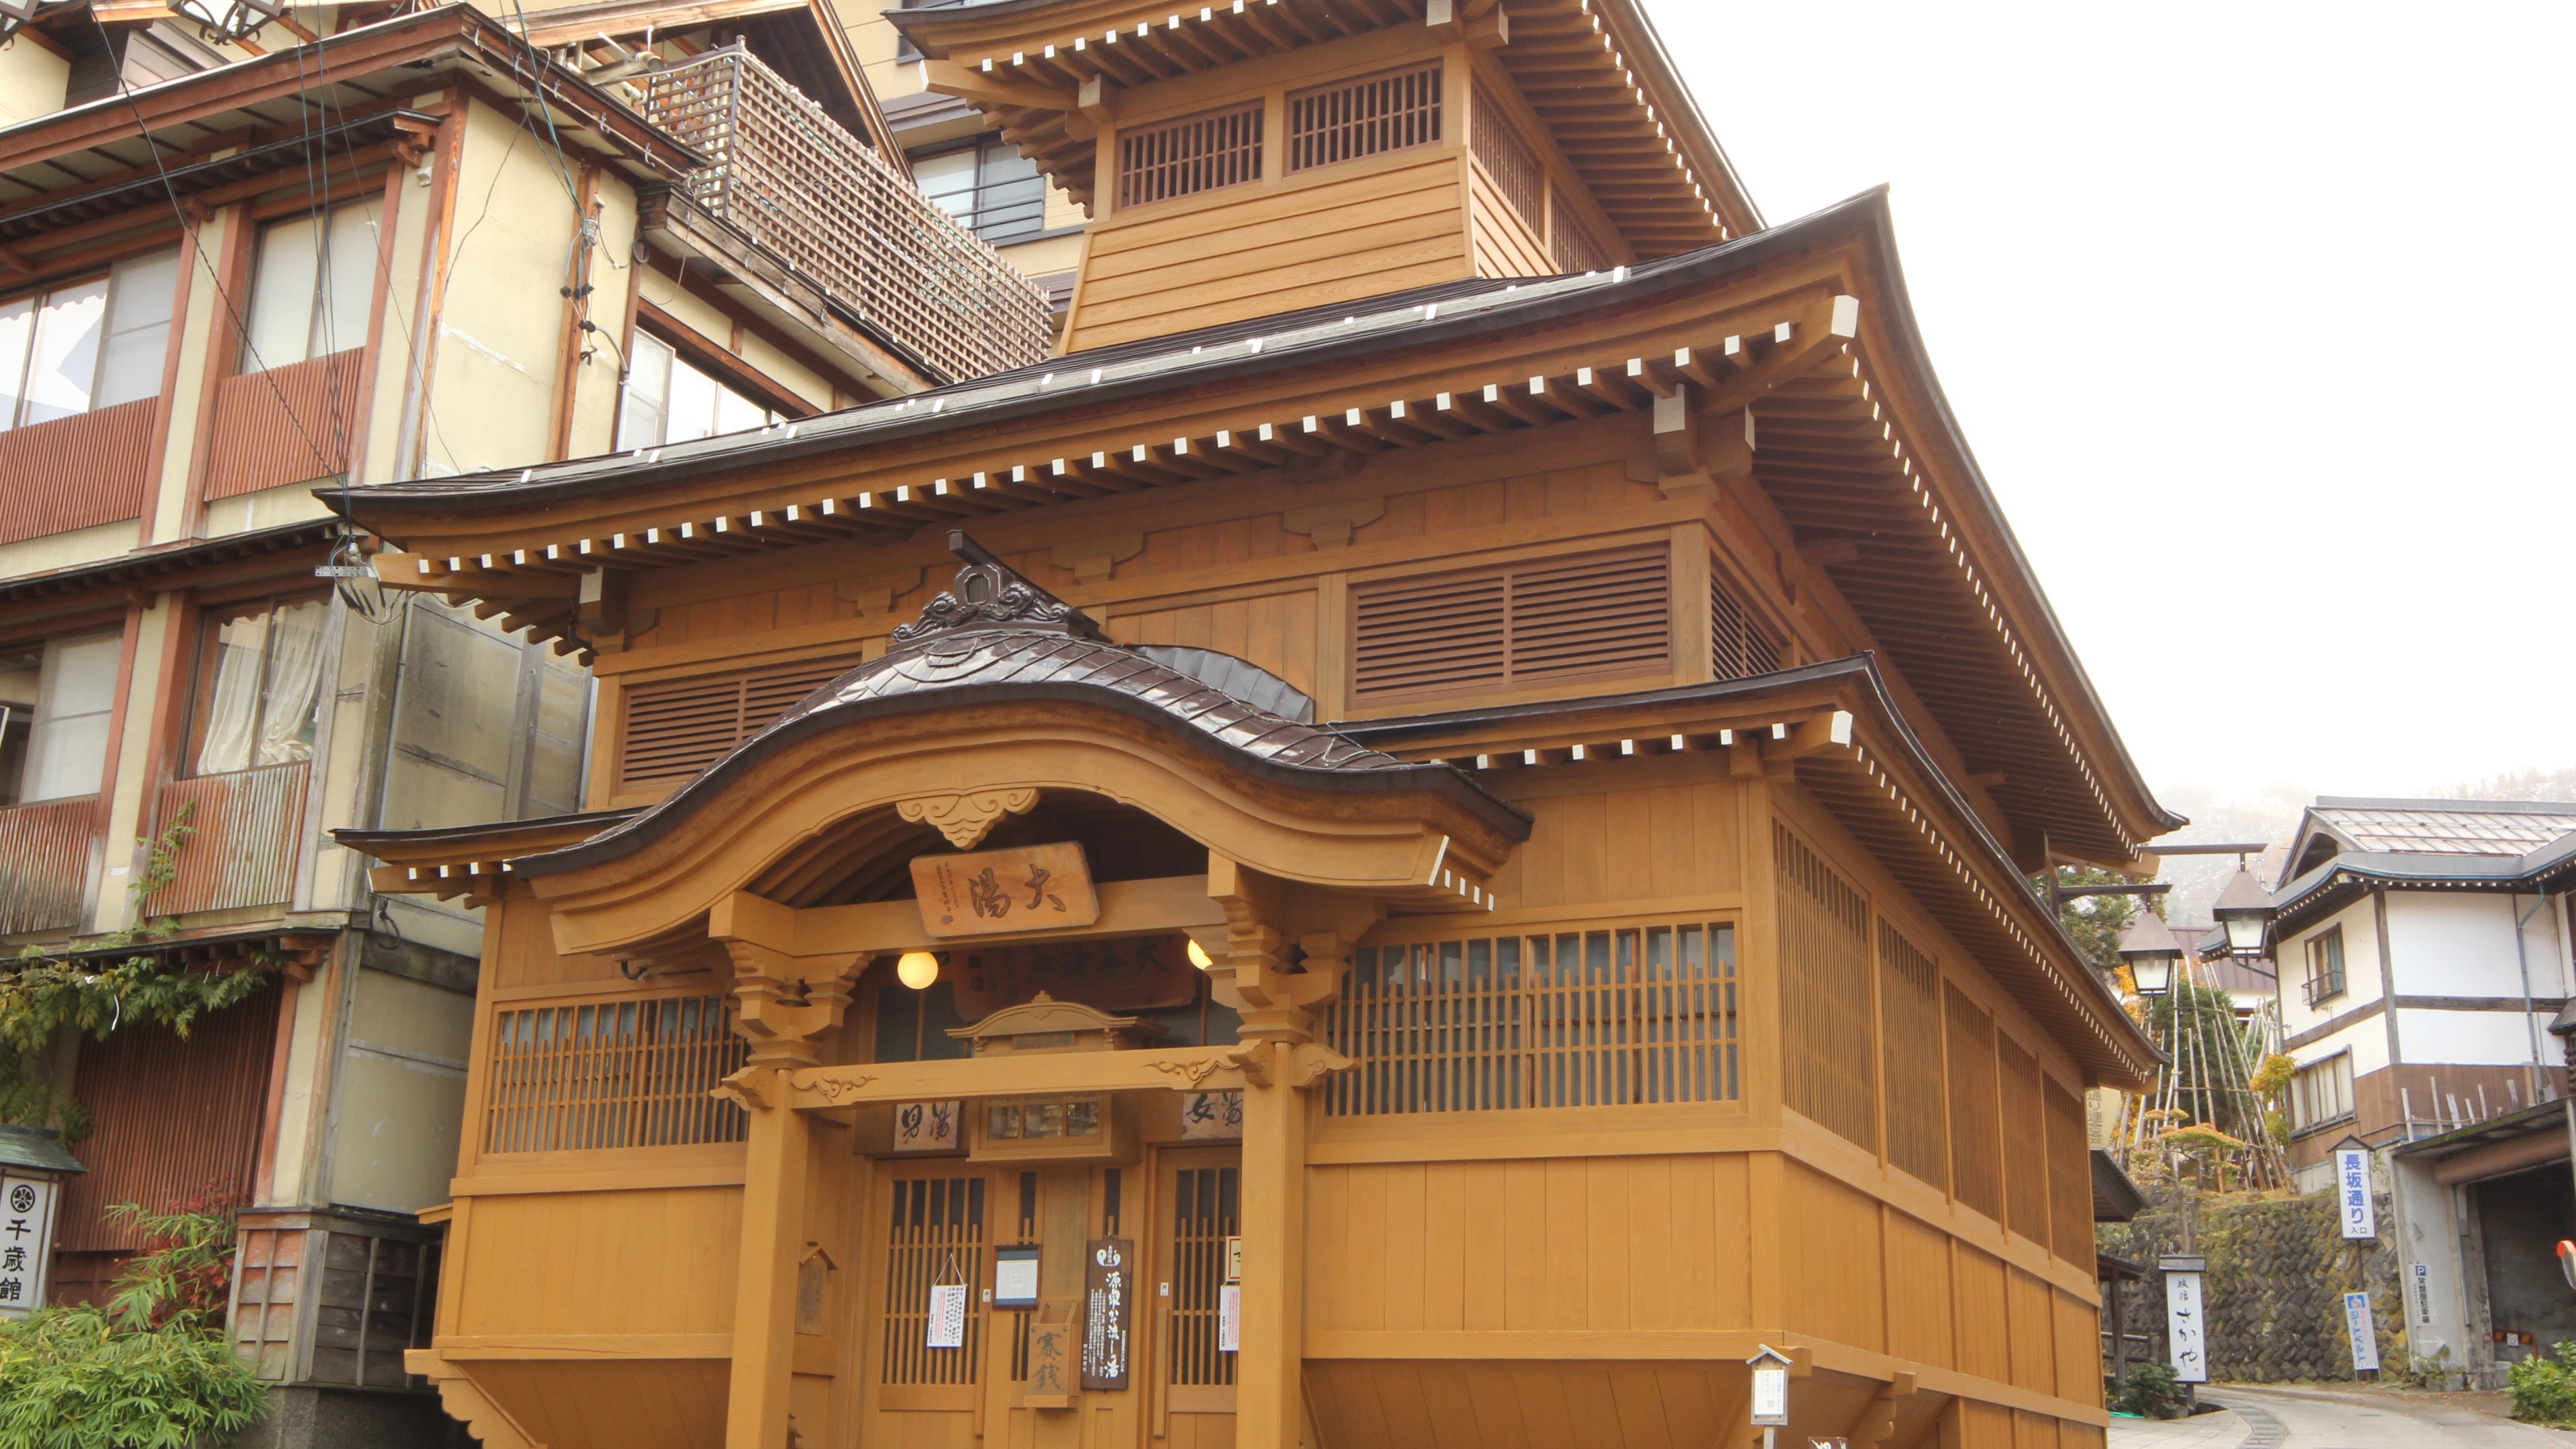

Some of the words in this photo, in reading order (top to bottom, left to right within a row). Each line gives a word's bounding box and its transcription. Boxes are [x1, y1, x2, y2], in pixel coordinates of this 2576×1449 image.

[968, 865, 1067, 919] 大湯
[2345, 1154, 2364, 1224] 長坂通り
[0, 1219, 31, 1302] 千歳館
[2417, 1266, 2425, 1276] P
[2176, 1307, 2198, 1368] さかや
